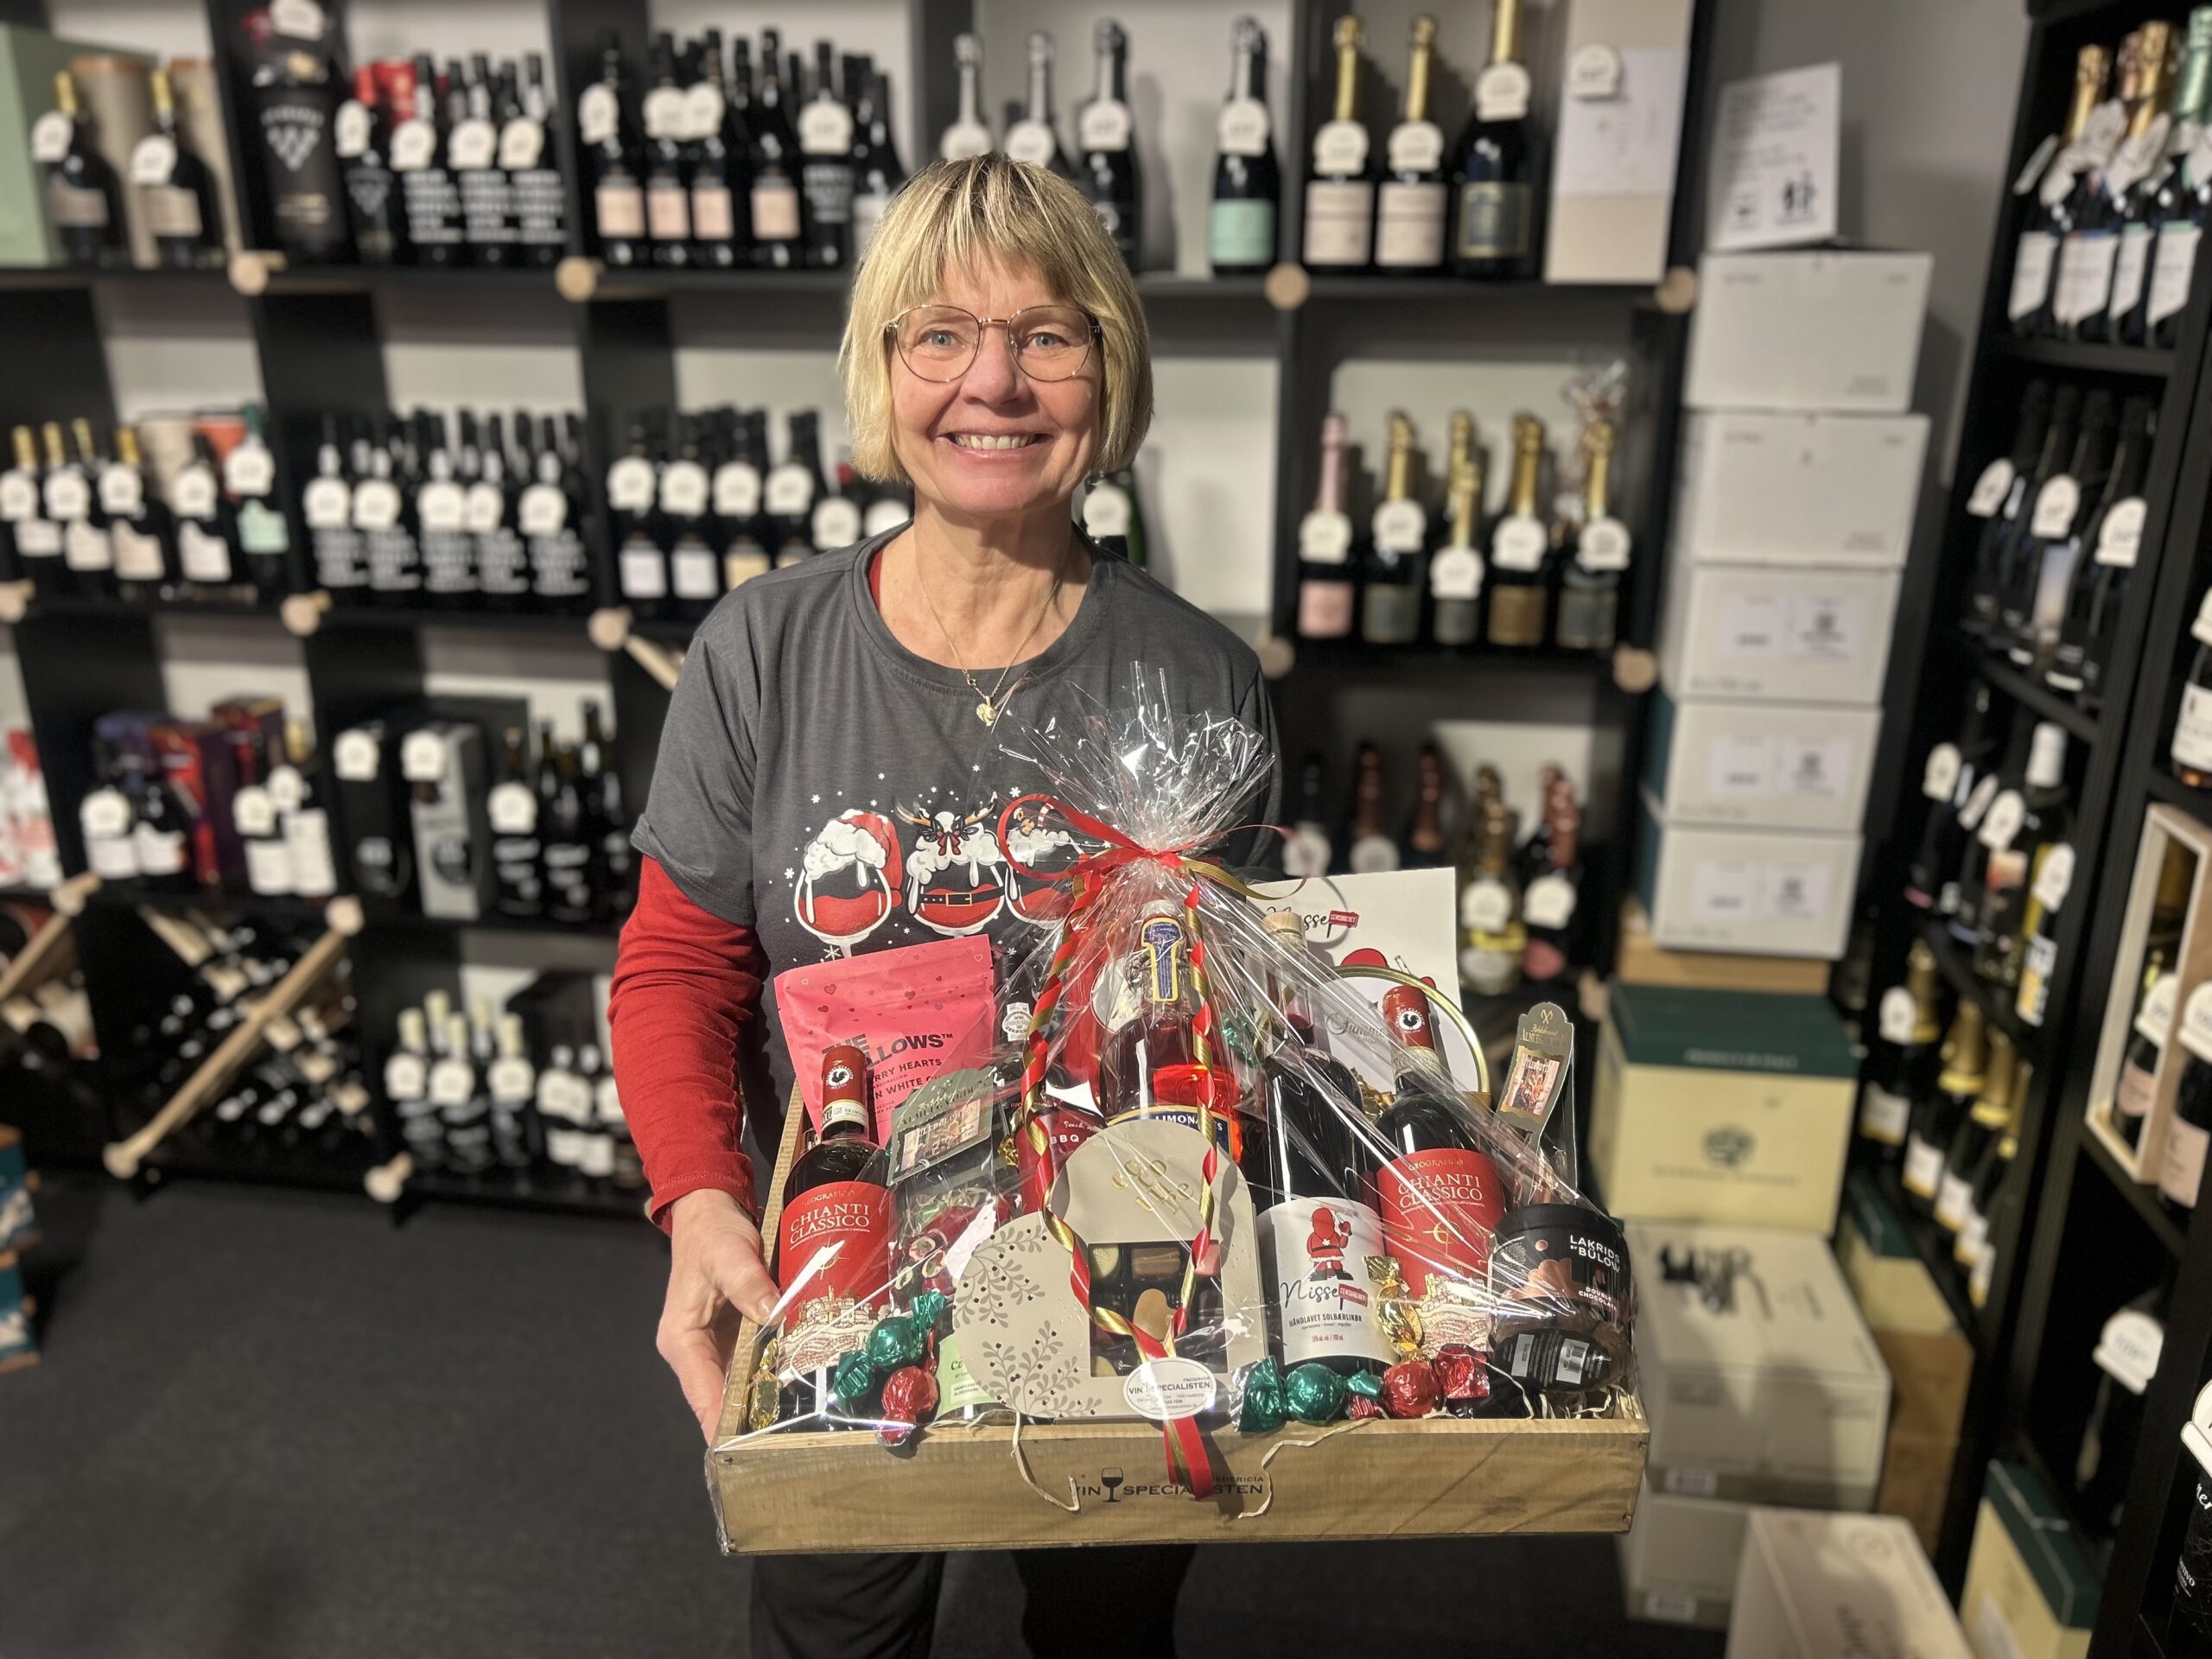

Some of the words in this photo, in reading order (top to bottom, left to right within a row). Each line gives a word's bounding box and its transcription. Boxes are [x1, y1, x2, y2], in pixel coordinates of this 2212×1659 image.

[899, 1058, 942, 1071] HEARTS
[886, 1077, 923, 1093] WHITE
[1398, 1173, 1480, 1195] CHIANTI
[1400, 1186, 1483, 1208] CLASSICO
[790, 1203, 869, 1232] CHIANTI
[790, 1215, 870, 1244] CLASSICO
[1569, 1235, 1620, 1264] LAKRIDS
[1579, 1247, 1620, 1273] BÜLOW
[1578, 1290, 1618, 1312] CHOCOLATE
[1585, 1287, 1612, 1302] DOUBLE
[1289, 1314, 1321, 1328] HÅNDLAVET
[1322, 1313, 1363, 1323] SOLBÆRLIKØR
[1128, 1386, 1143, 1395] VIN
[1157, 1381, 1211, 1392] PECIALISTEN
[1123, 1484, 1263, 1496] SPECIASTEN
